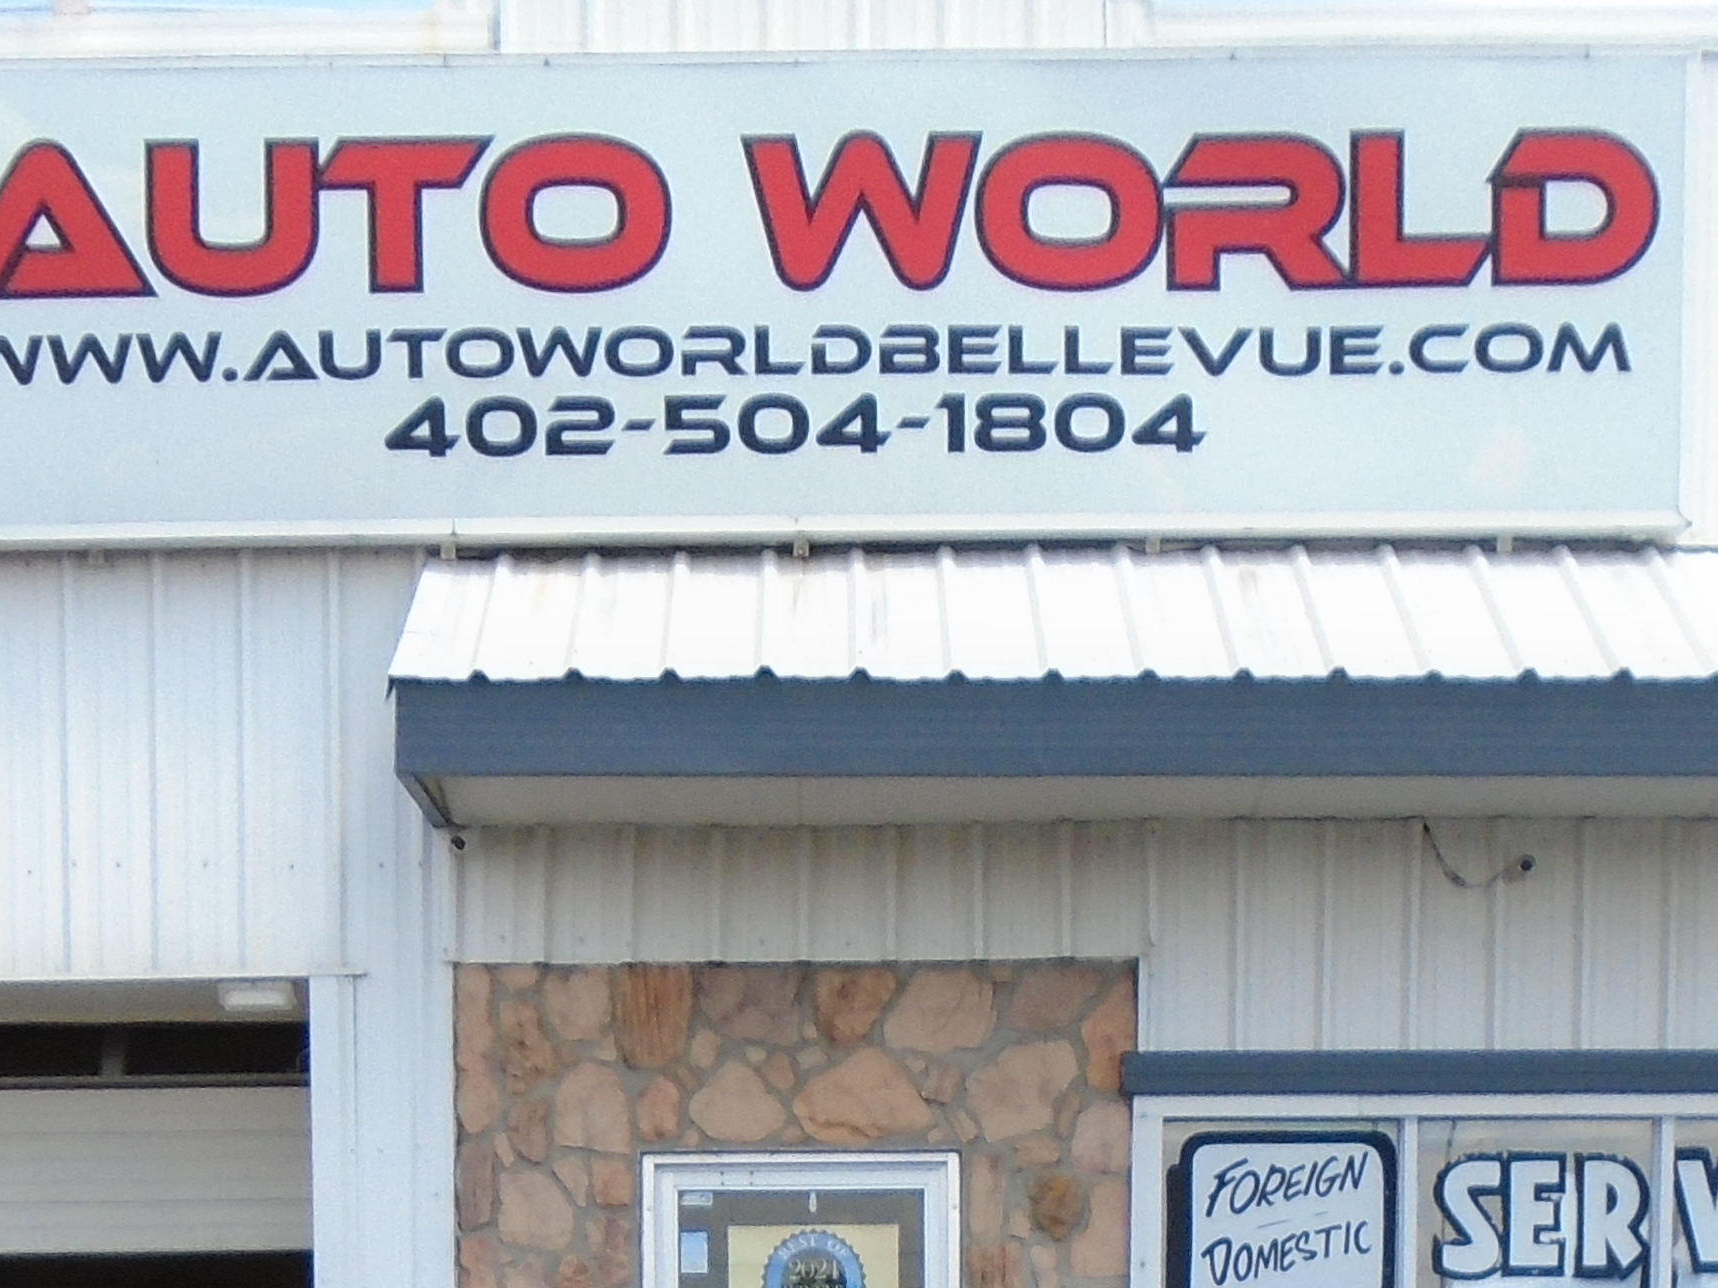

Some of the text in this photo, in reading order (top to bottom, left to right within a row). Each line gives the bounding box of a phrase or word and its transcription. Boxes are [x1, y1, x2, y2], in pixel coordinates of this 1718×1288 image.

[741, 128, 1659, 293] WORLD
[383, 390, 1207, 459] 402-504-1804
[1205, 1150, 1369, 1218] FOREIGN
[1200, 1219, 1373, 1287] DOMESTIC
